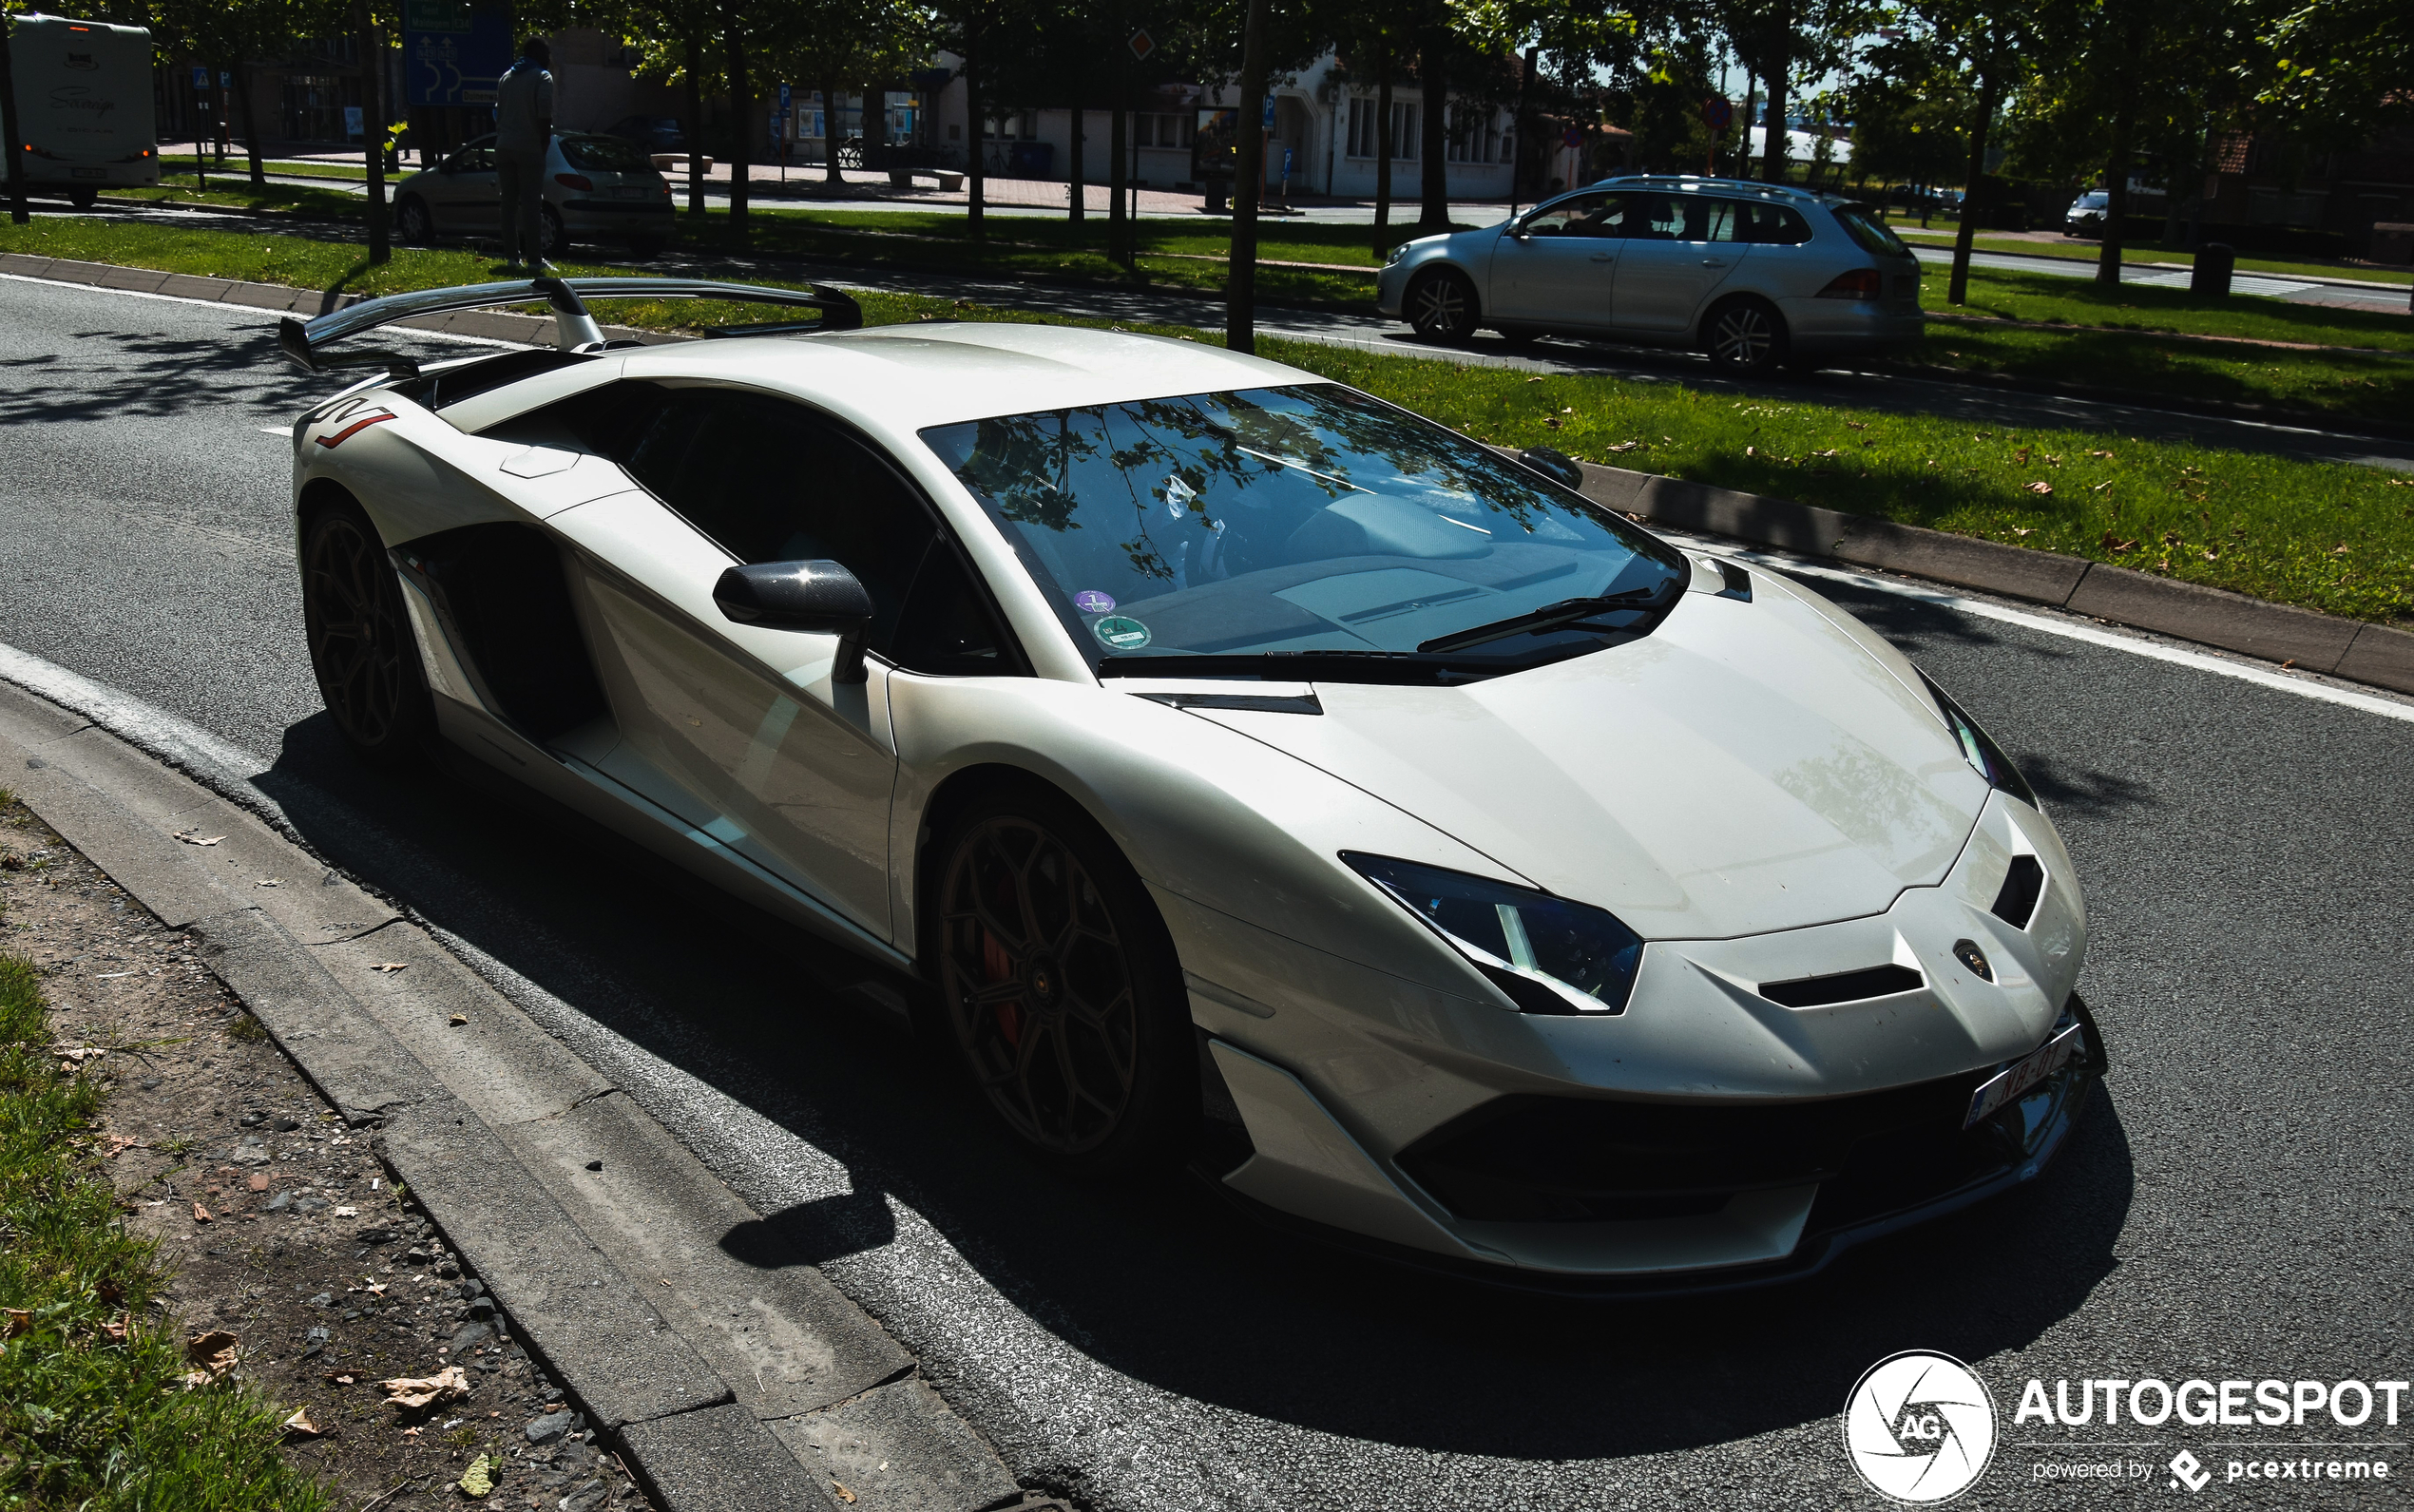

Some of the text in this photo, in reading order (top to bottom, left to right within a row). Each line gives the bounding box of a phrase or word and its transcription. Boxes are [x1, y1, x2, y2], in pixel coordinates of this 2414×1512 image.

[454, 18, 469, 29] E34
[418, 48, 434, 58] N49
[439, 49, 456, 59] N49
[220, 71, 229, 84] P
[781, 87, 789, 104] P
[1266, 99, 1274, 115] P
[1285, 153, 1292, 169] P
[1114, 621, 1127, 632] 4
